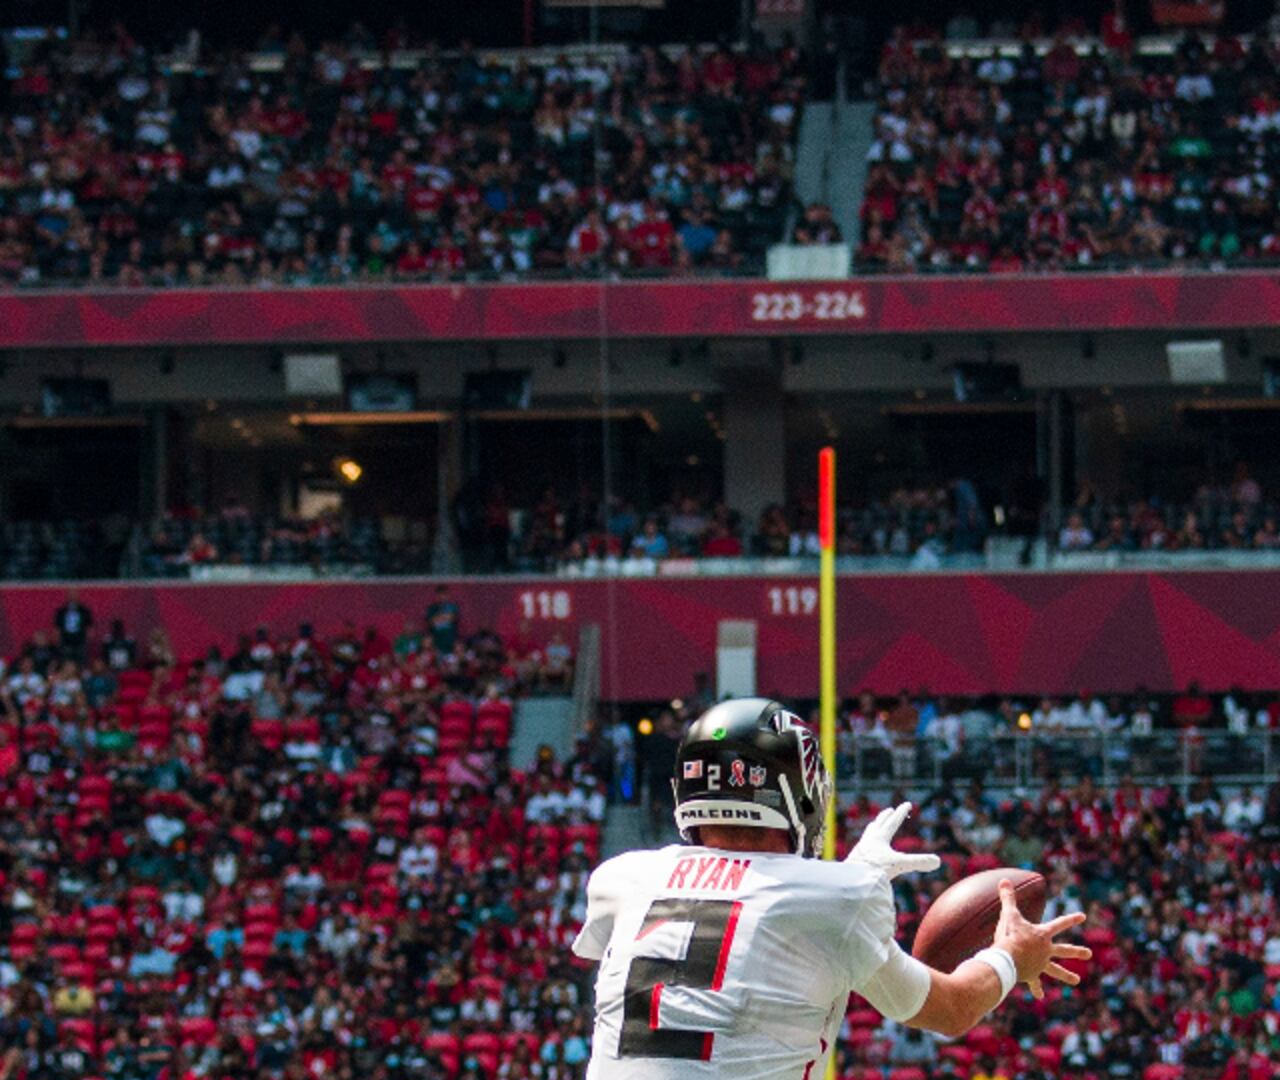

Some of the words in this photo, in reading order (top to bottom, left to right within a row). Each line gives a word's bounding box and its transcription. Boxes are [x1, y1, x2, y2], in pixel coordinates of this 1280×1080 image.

[753, 291, 865, 320] 223-224
[520, 591, 570, 619] 118
[769, 587, 818, 615] 119
[706, 764, 721, 791] 2
[666, 857, 752, 892] RYAN
[618, 897, 744, 1063] 2
